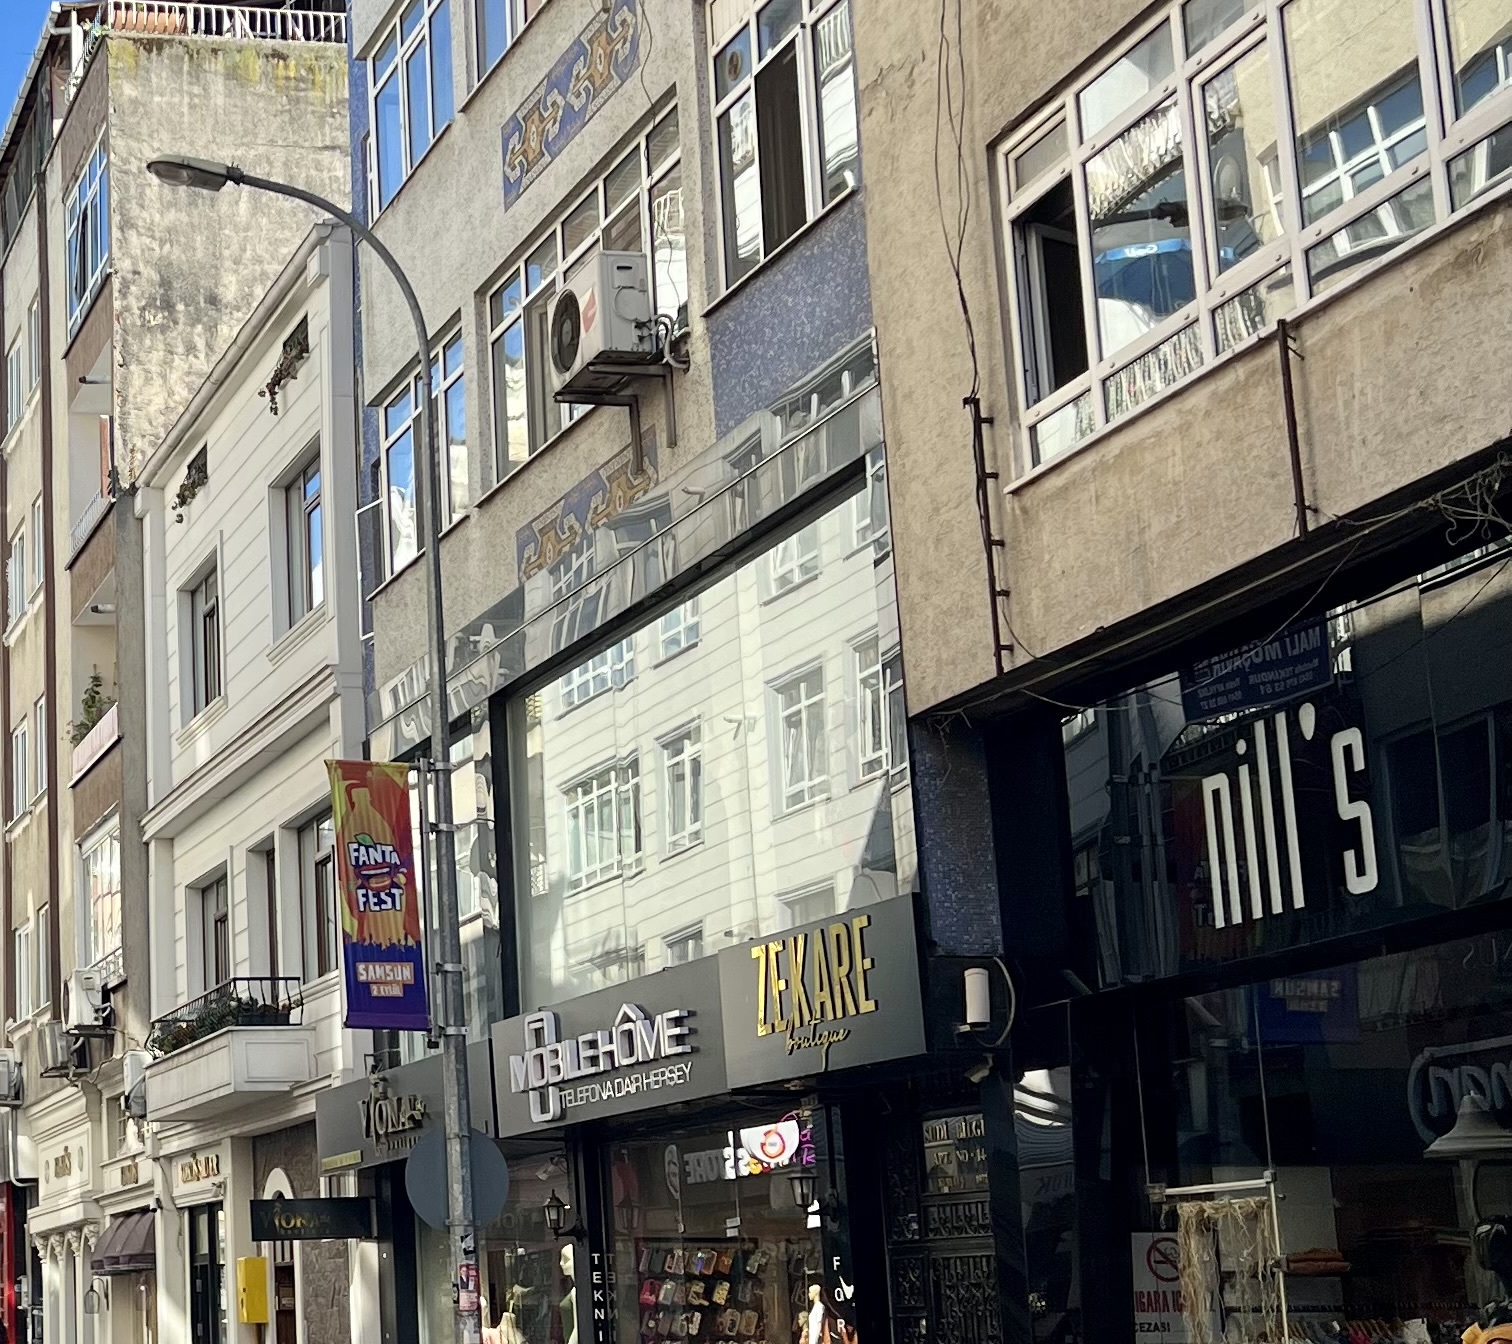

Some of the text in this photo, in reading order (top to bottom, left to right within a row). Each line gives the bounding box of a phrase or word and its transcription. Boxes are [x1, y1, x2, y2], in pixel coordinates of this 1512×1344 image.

[1201, 702, 1379, 930] nill's
[347, 841, 401, 866] FANTA
[356, 887, 405, 913] FEST
[358, 963, 412, 982] SAMSUN
[750, 913, 877, 1037] ZEKARE
[786, 1007, 850, 1072] boutique
[559, 1081, 615, 1109] TELEFONA
